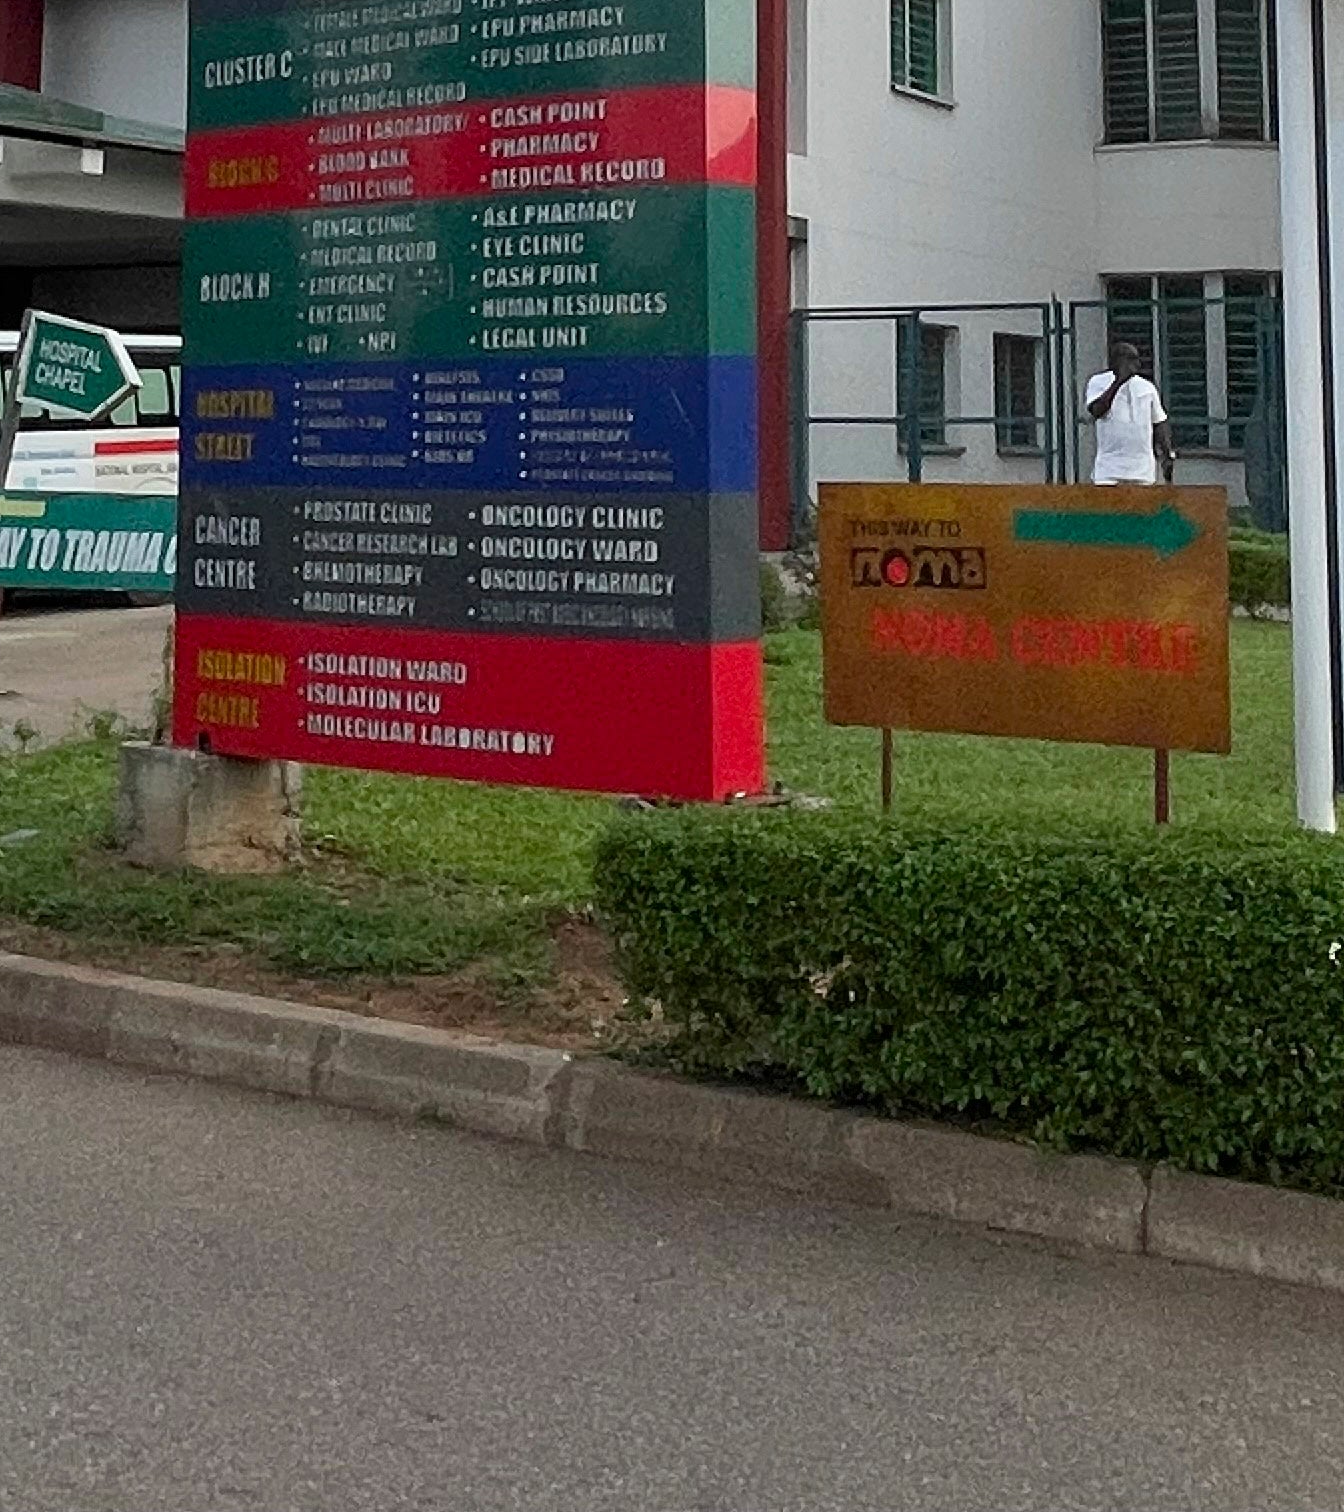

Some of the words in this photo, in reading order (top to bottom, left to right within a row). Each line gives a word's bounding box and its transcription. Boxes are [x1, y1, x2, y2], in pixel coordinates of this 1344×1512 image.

[482, 16, 514, 39] EPU
[520, 6, 624, 36] PHARMACY
[481, 45, 510, 68] EPU
[514, 42, 550, 66] SIDE
[556, 32, 667, 62] LABORATORY
[205, 52, 276, 88] CLUSTER
[280, 50, 293, 77] C
[491, 105, 542, 128] CASH
[547, 99, 607, 123] POINT
[491, 132, 599, 158] PHARMACY
[318, 151, 365, 174] BLOOD
[369, 149, 409, 169] BANK
[491, 164, 575, 189] MEDICAL
[580, 157, 666, 182] RECORD
[319, 181, 362, 202] MULTI
[365, 175, 414, 199] CLINIC
[312, 219, 363, 239] DENTAL
[366, 213, 416, 236] CLINIC
[310, 246, 372, 267] MEDICAL
[377, 240, 436, 263] RECORD
[483, 237, 514, 258] EYE
[519, 232, 584, 256] CLINIC
[200, 273, 253, 302] BLOCK
[258, 272, 270, 299] H
[309, 272, 396, 296] EMERGENCY
[483, 266, 534, 288] CASH
[540, 263, 599, 286] POINT
[308, 304, 334, 323] ENT
[337, 303, 386, 323] CLINIC
[482, 296, 547, 319] HUMAN
[552, 292, 668, 316] RESOURCES
[482, 328, 537, 350] LEGAL
[542, 326, 588, 348] UNIT
[39, 338, 102, 373] HOSPITAL
[35, 365, 86, 395] CHAPEL
[304, 501, 376, 523] PROSTATE
[380, 503, 432, 525] CLINIC
[482, 504, 585, 528] ONCOLOGY
[592, 506, 664, 530] CLINIC
[195, 515, 260, 547] CANCER
[852, 519, 891, 537] THIS
[894, 520, 933, 538] WAY
[938, 521, 961, 538] TO
[26, 528, 59, 570] TO
[62, 530, 164, 573] TRAUMA
[303, 531, 354, 552] CANCER
[357, 534, 428, 555] RESEARCH
[431, 536, 458, 557] LAB
[480, 537, 587, 560] ONCOLOGY
[591, 540, 658, 562] WARD
[194, 558, 256, 590] CENTRE
[303, 561, 423, 586] CHEMOTHERAPY
[480, 567, 569, 592] ONCOLOGY
[574, 571, 676, 596] PHARMACY
[303, 591, 416, 617] RADIOTHERAPY
[870, 605, 998, 661] NOMA
[1010, 614, 1197, 674] CENTRE
[198, 648, 286, 685] ISOLATION
[307, 652, 401, 680] ISOLATION
[405, 659, 468, 684] WARD
[307, 683, 401, 710] ISOLATION
[406, 690, 441, 714] ICU
[307, 714, 416, 744] MOLECULAR
[420, 722, 555, 756] LABORATORY
